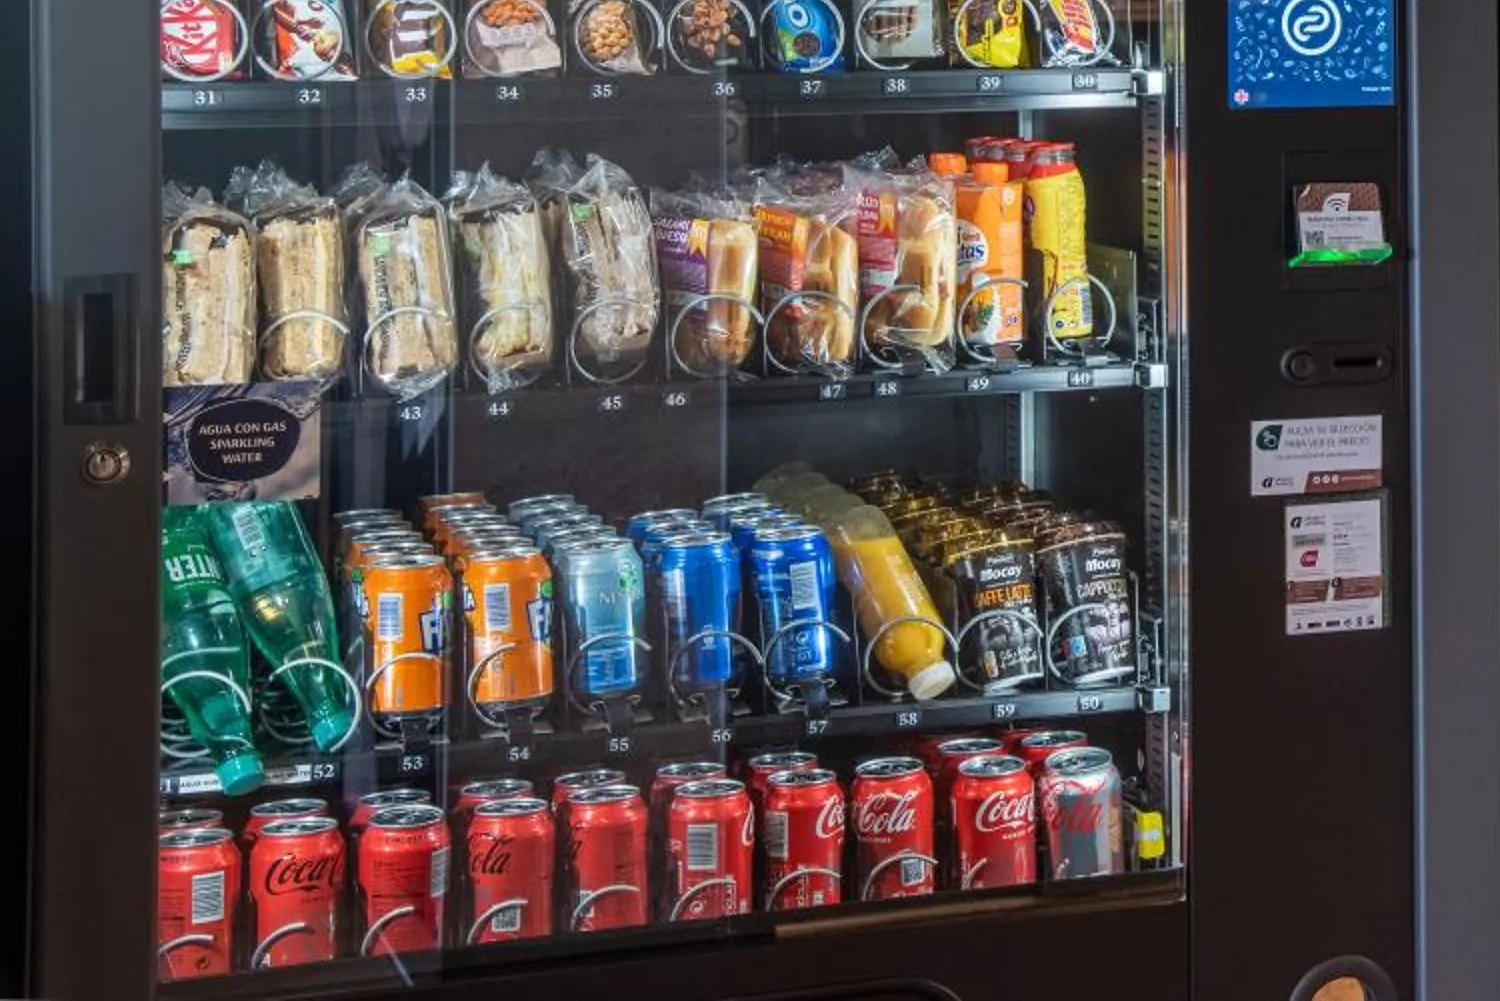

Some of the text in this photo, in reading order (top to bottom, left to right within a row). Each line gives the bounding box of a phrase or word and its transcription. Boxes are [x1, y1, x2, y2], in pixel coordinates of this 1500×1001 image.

[714, 82, 735, 95] 36
[802, 80, 822, 94] 37
[887, 78, 907, 91] 38
[980, 76, 1000, 89] 39
[195, 91, 216, 105] 31
[299, 90, 321, 104] 32
[406, 88, 427, 101] 33
[499, 87, 520, 100] 34
[593, 84, 613, 98] 35
[969, 377, 989, 390] 49
[1070, 372, 1090, 386] 40
[822, 384, 842, 398] 47
[878, 382, 897, 395] 48
[601, 396, 622, 409] 45
[665, 393, 686, 406] 46
[401, 406, 422, 420] 43
[488, 403, 509, 416] 44
[199, 421, 287, 436] AGUA CON GAS
[209, 437, 276, 451] SPARKLING
[222, 451, 263, 465] WATER
[996, 704, 1015, 718] 59
[807, 720, 829, 734] 57
[899, 713, 919, 727] 58
[711, 730, 732, 744] 56
[608, 738, 629, 752] 55
[508, 746, 530, 761] 54
[402, 756, 424, 770] 53
[314, 764, 335, 779] 52
[857, 790, 918, 833] Cola
